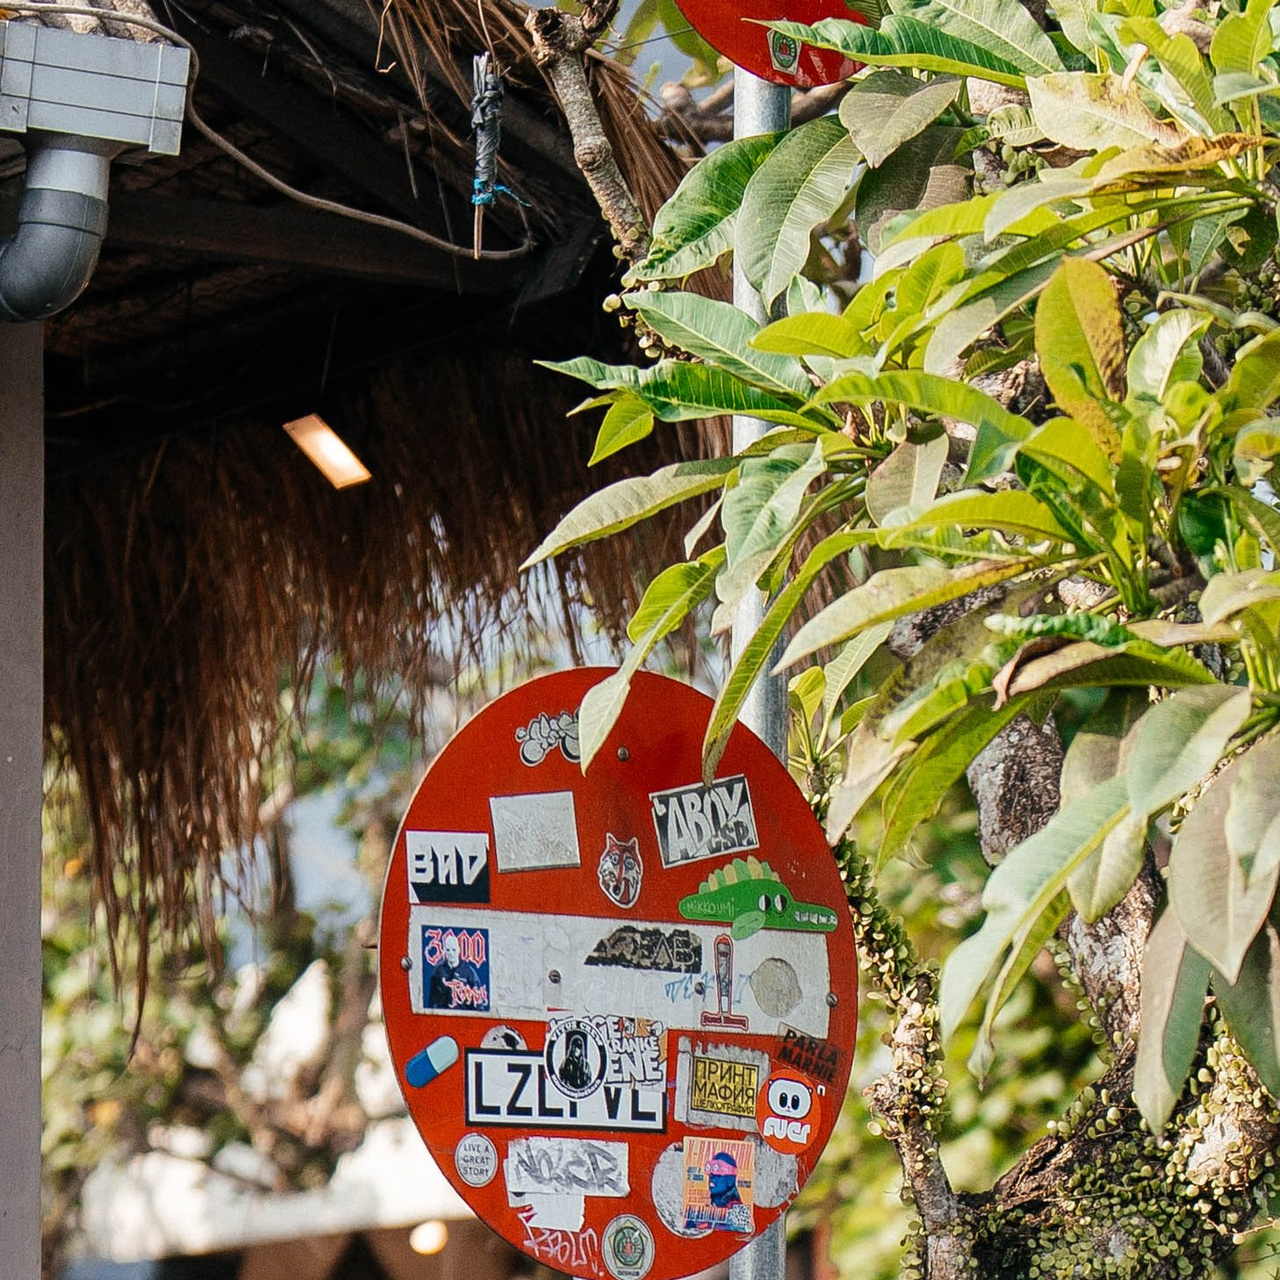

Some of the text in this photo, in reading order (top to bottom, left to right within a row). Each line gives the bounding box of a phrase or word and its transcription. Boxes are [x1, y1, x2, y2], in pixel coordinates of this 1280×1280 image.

[695, 1060, 756, 1086] ПРИНТ
[475, 1061, 656, 1121] LZLVL
[694, 1080, 755, 1106] МАФИЯ
[463, 1143, 490, 1153] LIVE A
[463, 1155, 490, 1165] GREAT
[463, 1166, 489, 1177] STORY
